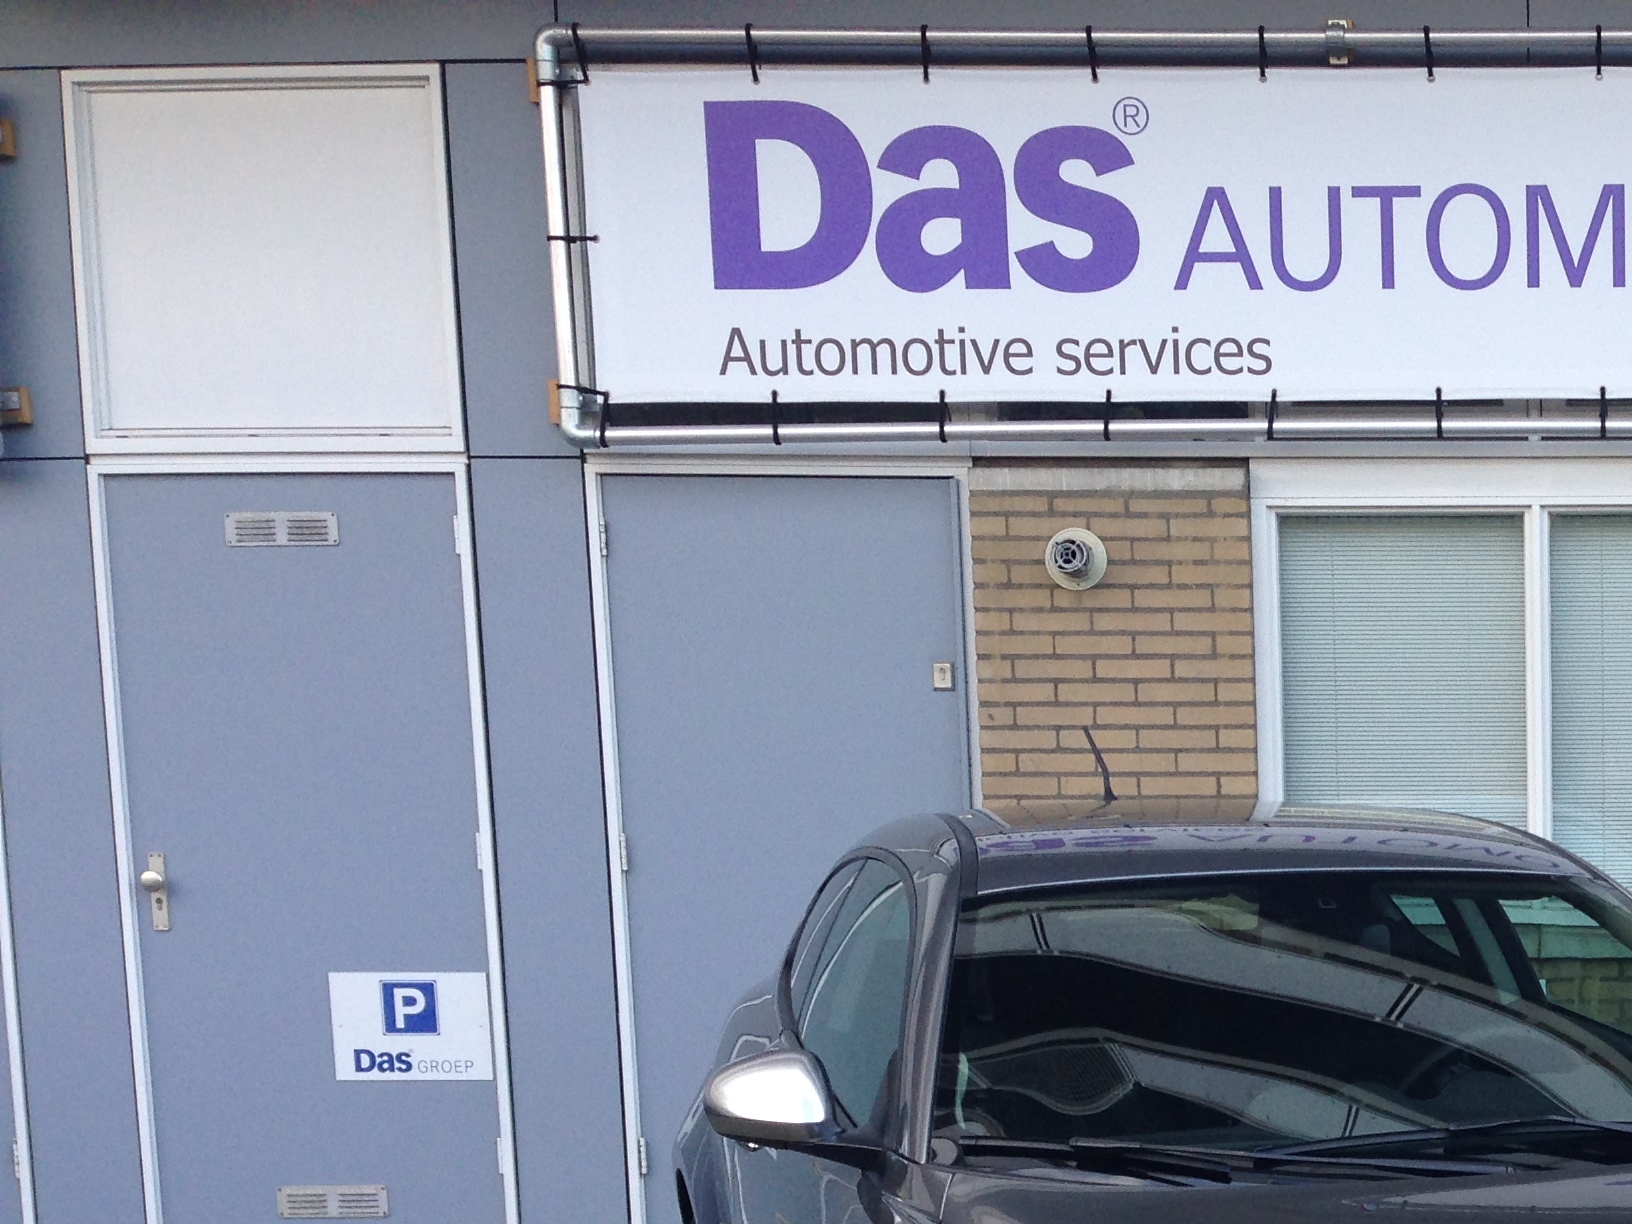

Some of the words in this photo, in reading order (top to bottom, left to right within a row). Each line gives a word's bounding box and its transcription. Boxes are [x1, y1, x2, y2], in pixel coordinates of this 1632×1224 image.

[719, 327, 1033, 376] Automotive
[1056, 327, 1272, 376] services
[393, 987, 426, 1029] P
[353, 1048, 413, 1073] Das
[417, 1059, 474, 1074] GROEP
